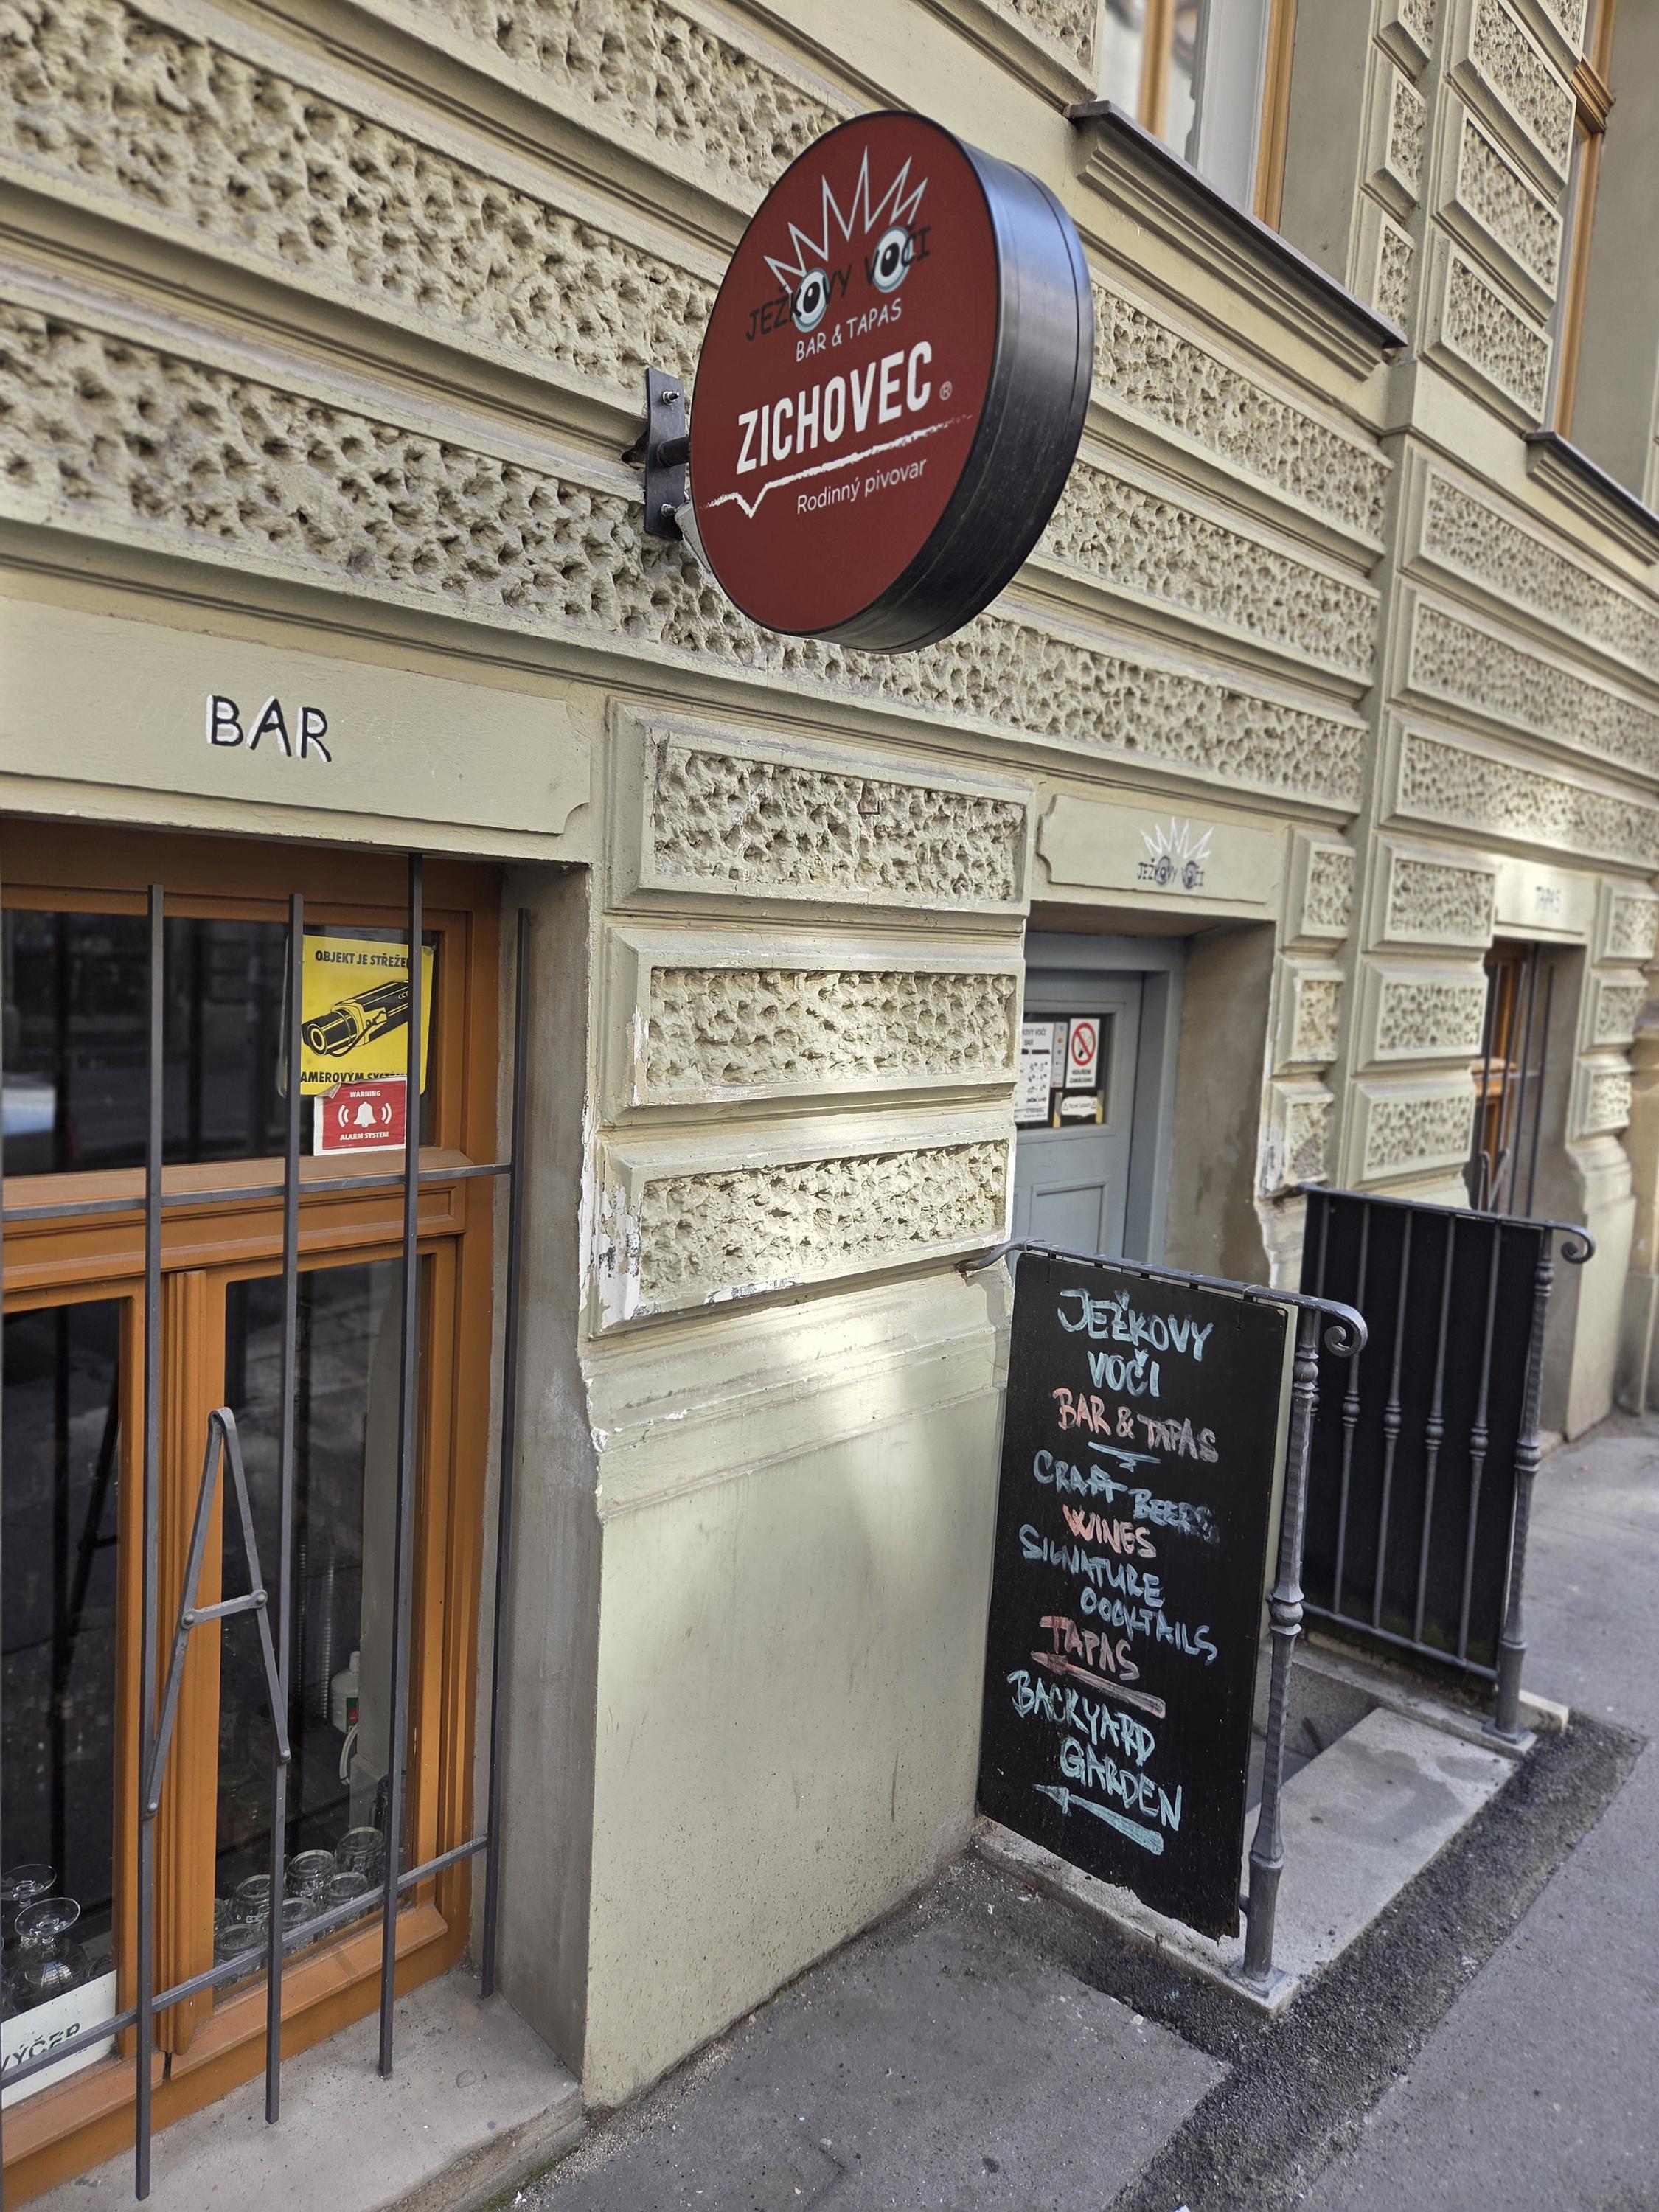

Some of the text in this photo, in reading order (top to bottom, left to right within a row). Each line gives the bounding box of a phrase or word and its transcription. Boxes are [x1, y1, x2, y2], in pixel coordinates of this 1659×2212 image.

[796, 298, 902, 362] BAR & TAPAS
[737, 341, 933, 475] ZICHOVEC
[797, 459, 927, 515] Rodinný pivovar
[206, 695, 332, 762] BAR
[315, 950, 408, 968] OBJEKT JE STŘEŽE
[339, 1131, 389, 1141] ALARM SYSTEM
[1057, 1288, 1214, 1362] JEŽKOVY
[1087, 1348, 1160, 1397] VOČI
[1052, 1387, 1219, 1463] BAR & TAPAS
[1033, 1450, 1129, 1503] CRAFT
[1062, 1503, 1156, 1558] WINES
[1039, 1615, 1140, 1680] TAPAS
[1006, 1669, 1155, 1767] BACKYARD
[1060, 1736, 1183, 1831] GARDEN
